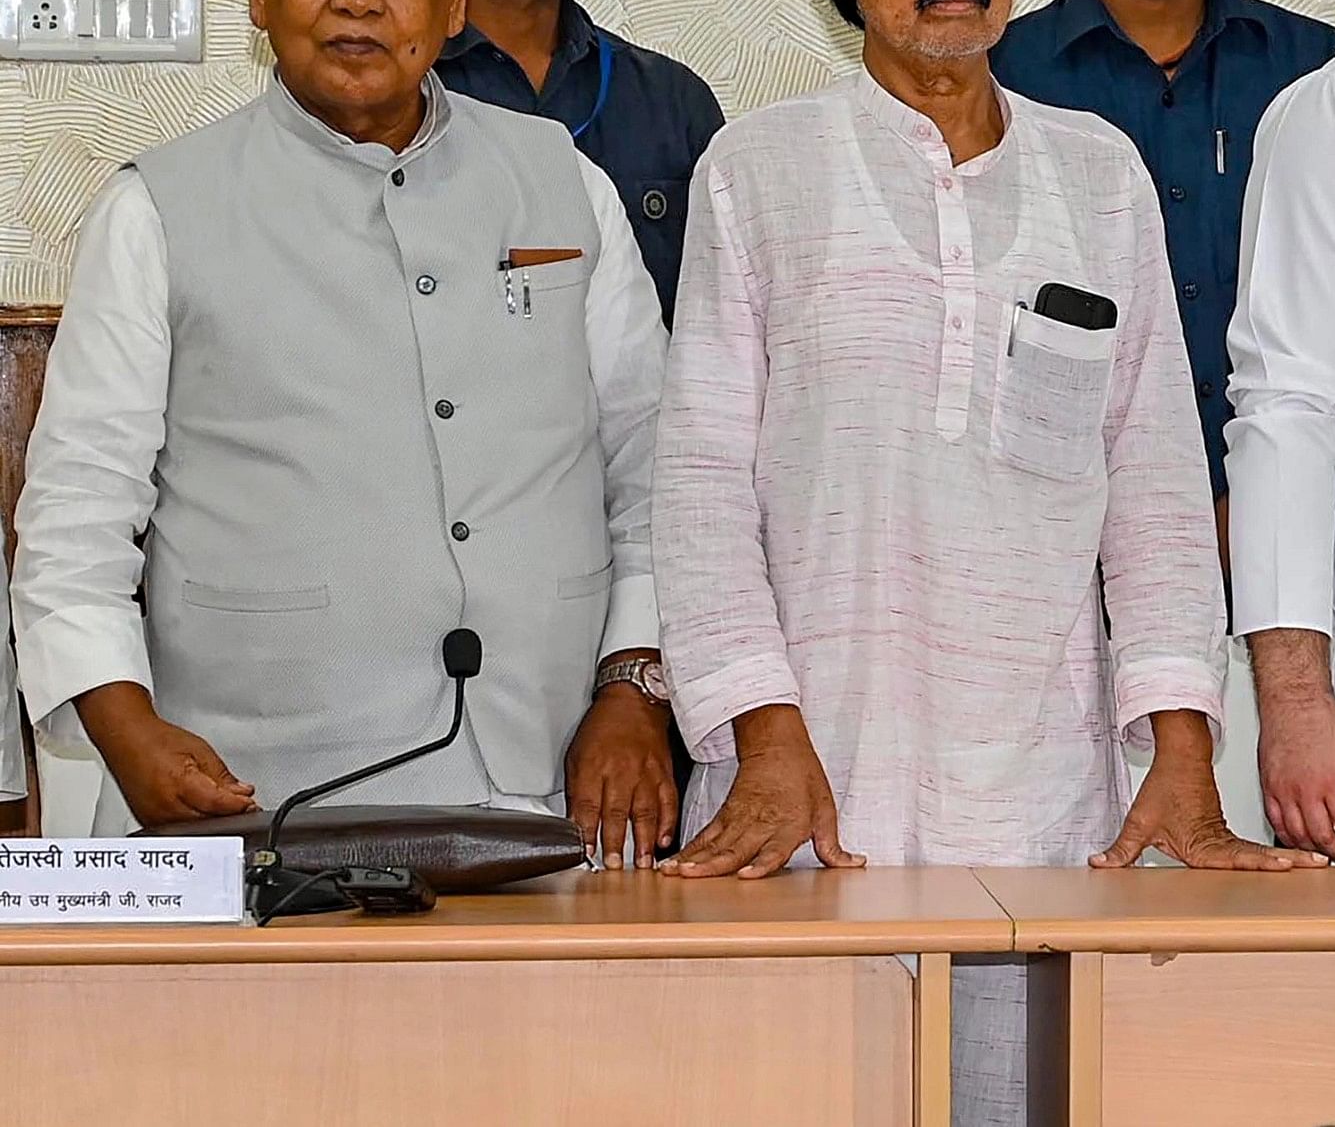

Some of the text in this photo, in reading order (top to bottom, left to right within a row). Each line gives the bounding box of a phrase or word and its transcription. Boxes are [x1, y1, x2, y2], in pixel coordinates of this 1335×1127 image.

[0, 843, 194, 871] तेजस्वी प्रसाद यादव,
[29, 895, 50, 907] उप
[56, 891, 111, 912] मुख्यमंत्री
[118, 891, 140, 909] जी,
[146, 895, 182, 908] राजद
